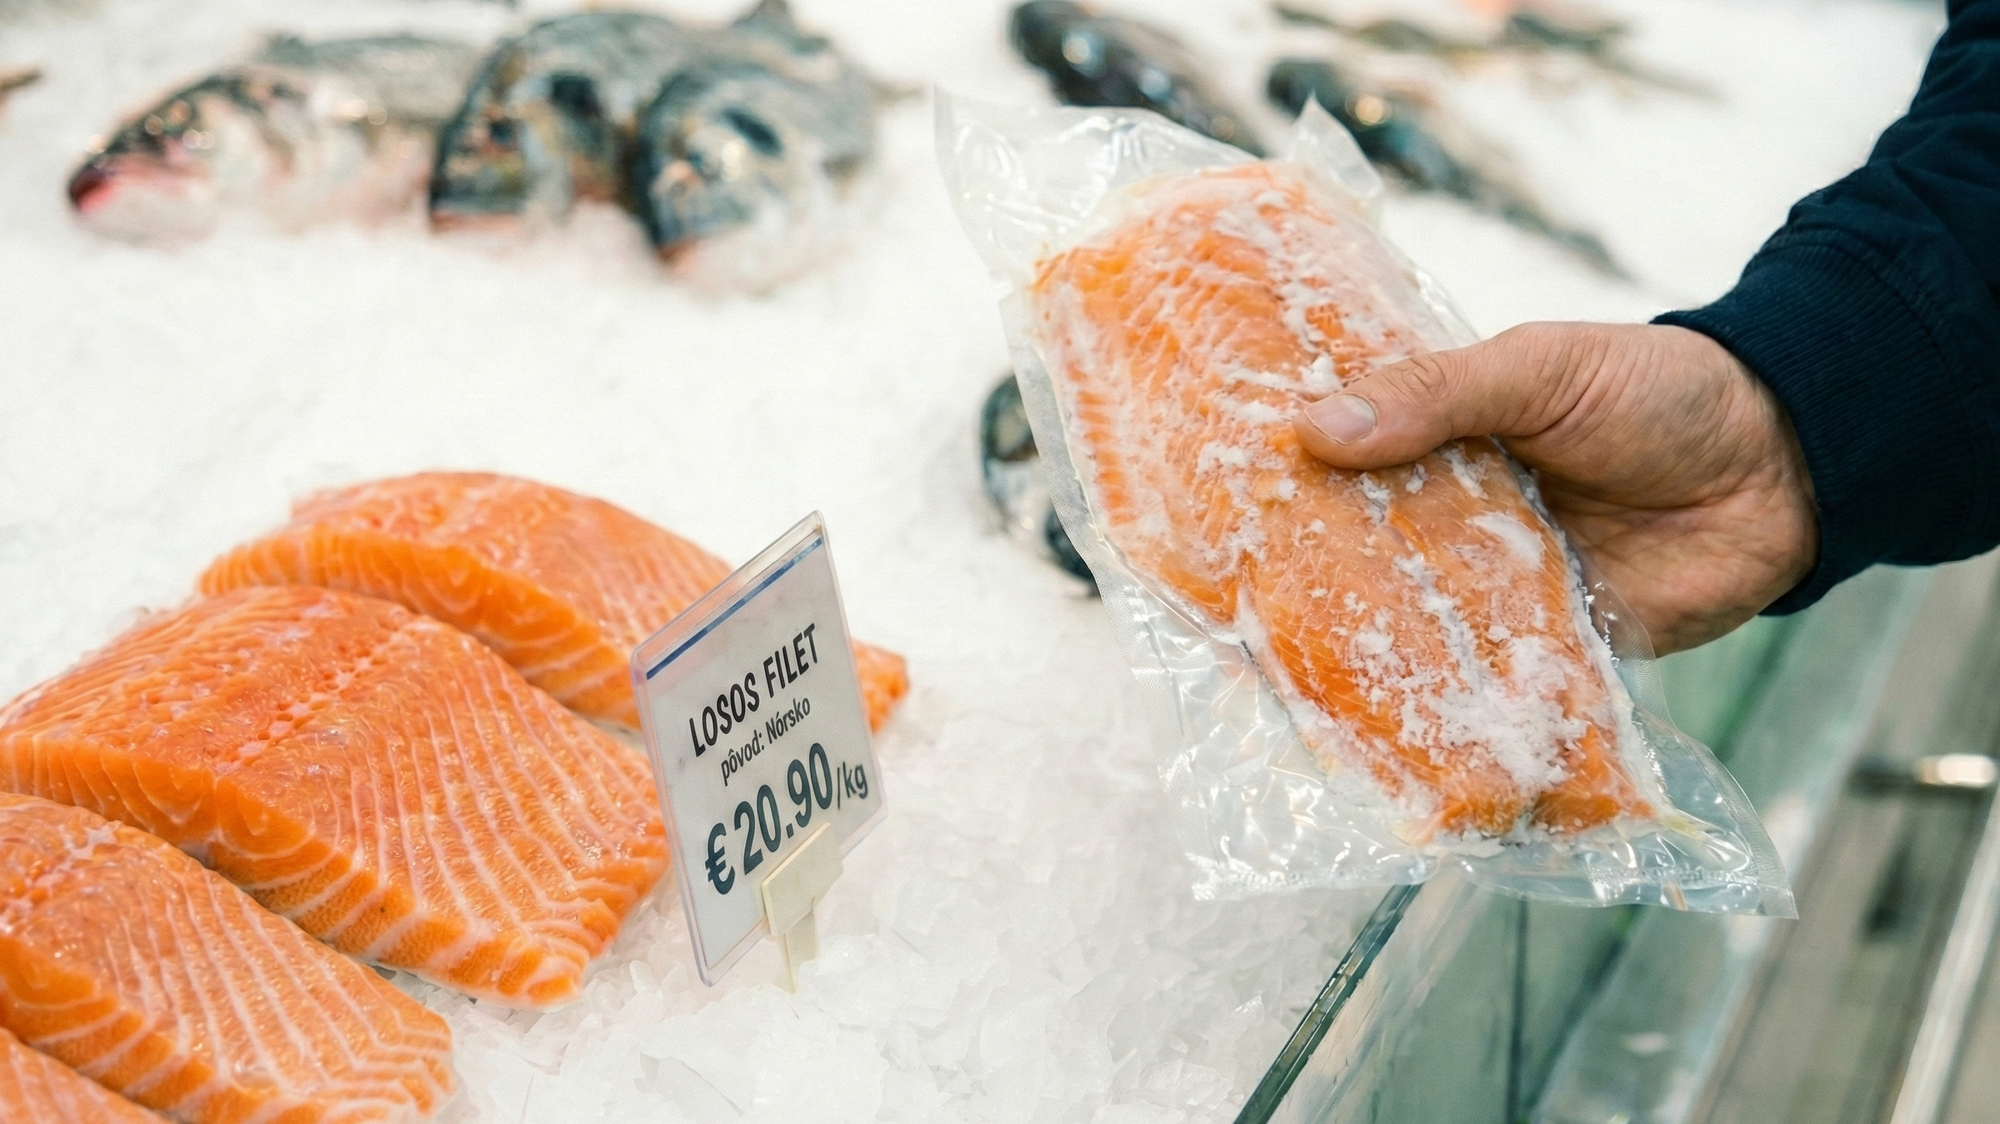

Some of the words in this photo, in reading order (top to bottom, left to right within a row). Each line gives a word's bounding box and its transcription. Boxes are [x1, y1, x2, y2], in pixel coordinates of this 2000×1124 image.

[689, 672, 760, 757] LOSOS
[763, 623, 819, 698] FILET
[721, 729, 765, 786] pôvod:
[765, 696, 811, 744] Nórsko
